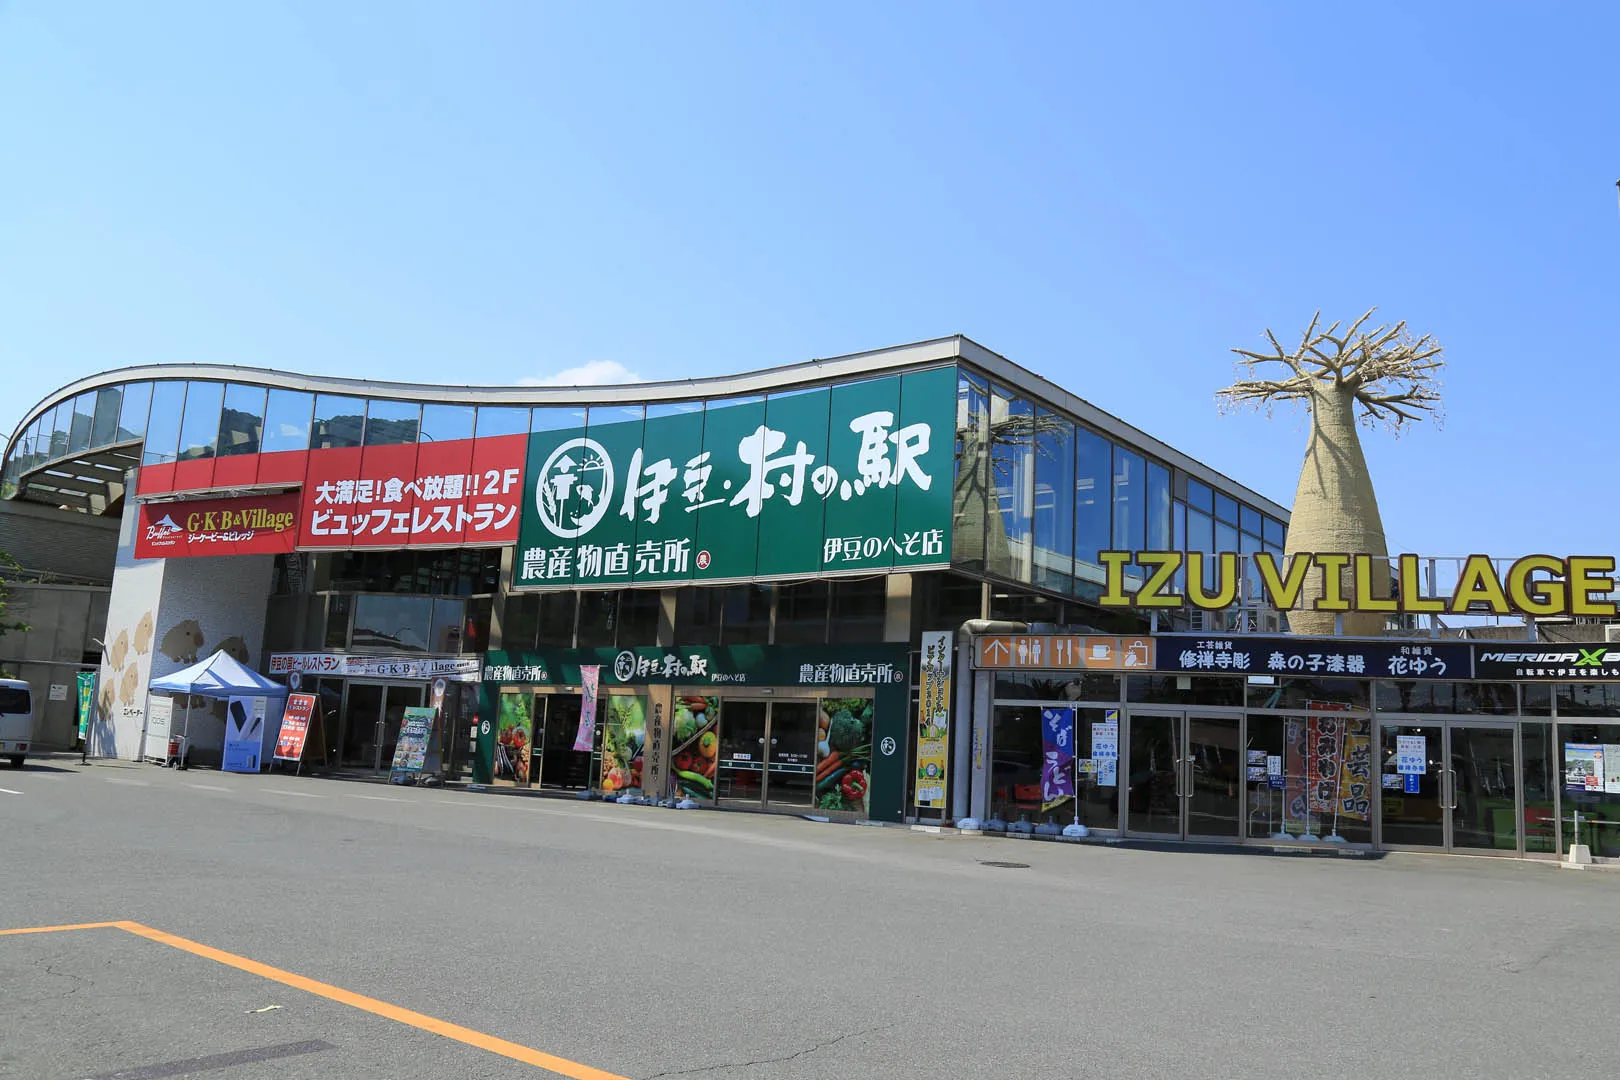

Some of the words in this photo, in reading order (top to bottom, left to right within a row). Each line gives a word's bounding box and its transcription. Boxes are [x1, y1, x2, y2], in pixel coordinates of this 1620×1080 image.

[310, 502, 518, 537] ビュッフェレストラン
[520, 537, 691, 580] 農産物直売所
[823, 529, 944, 564] 伊豆のへそ店
[1099, 551, 1237, 611] IZU
[1253, 552, 1619, 617] VILLAGE
[1179, 650, 1250, 669] 修禅寺彫
[1267, 651, 1367, 674] 森の子漆器
[1387, 655, 1447, 676] 花ゆう
[1400, 646, 1433, 656] 和雑貨
[483, 665, 542, 681] 農産物直売所
[799, 663, 893, 683] 農産物直売所
